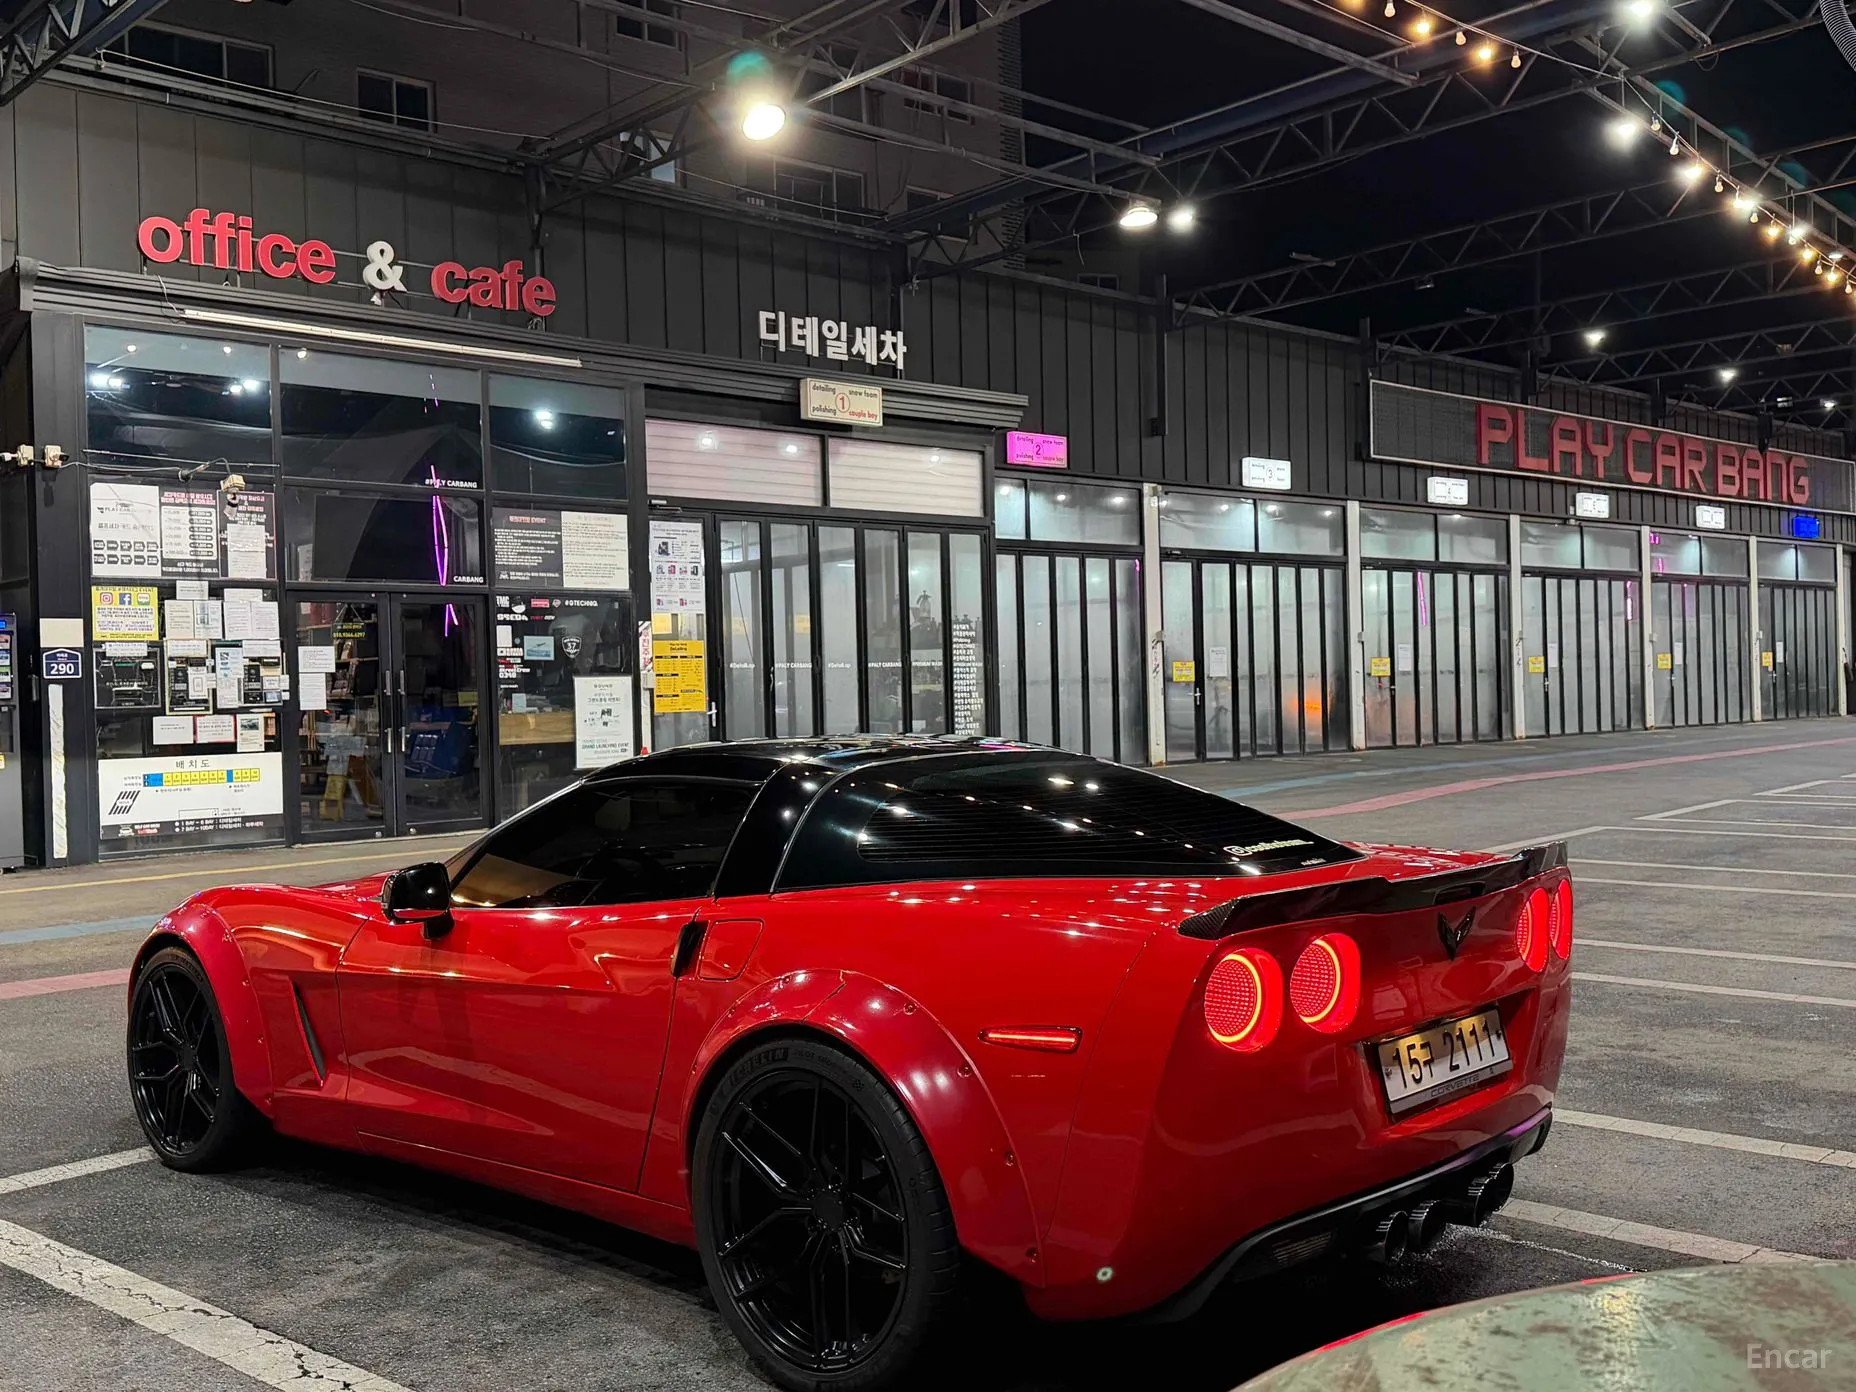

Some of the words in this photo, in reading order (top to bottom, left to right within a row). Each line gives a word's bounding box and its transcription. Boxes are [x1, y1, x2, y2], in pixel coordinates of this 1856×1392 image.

[138, 208, 336, 283] office
[363, 240, 407, 293] &
[430, 259, 557, 316] cafe
[758, 310, 907, 370] 디테일세차
[812, 405, 836, 416] polishing
[839, 396, 845, 410] 1
[1475, 402, 1614, 479] PLAY
[1623, 426, 1707, 494] CAR
[1715, 441, 1810, 506] BANG
[447, 480, 478, 488] CARBANG
[50, 663, 74, 674] 290
[1392, 1041, 1435, 1088] 15구
[1442, 1019, 1495, 1072] 2111
[1430, 1073, 1480, 1097] CORVETTE
